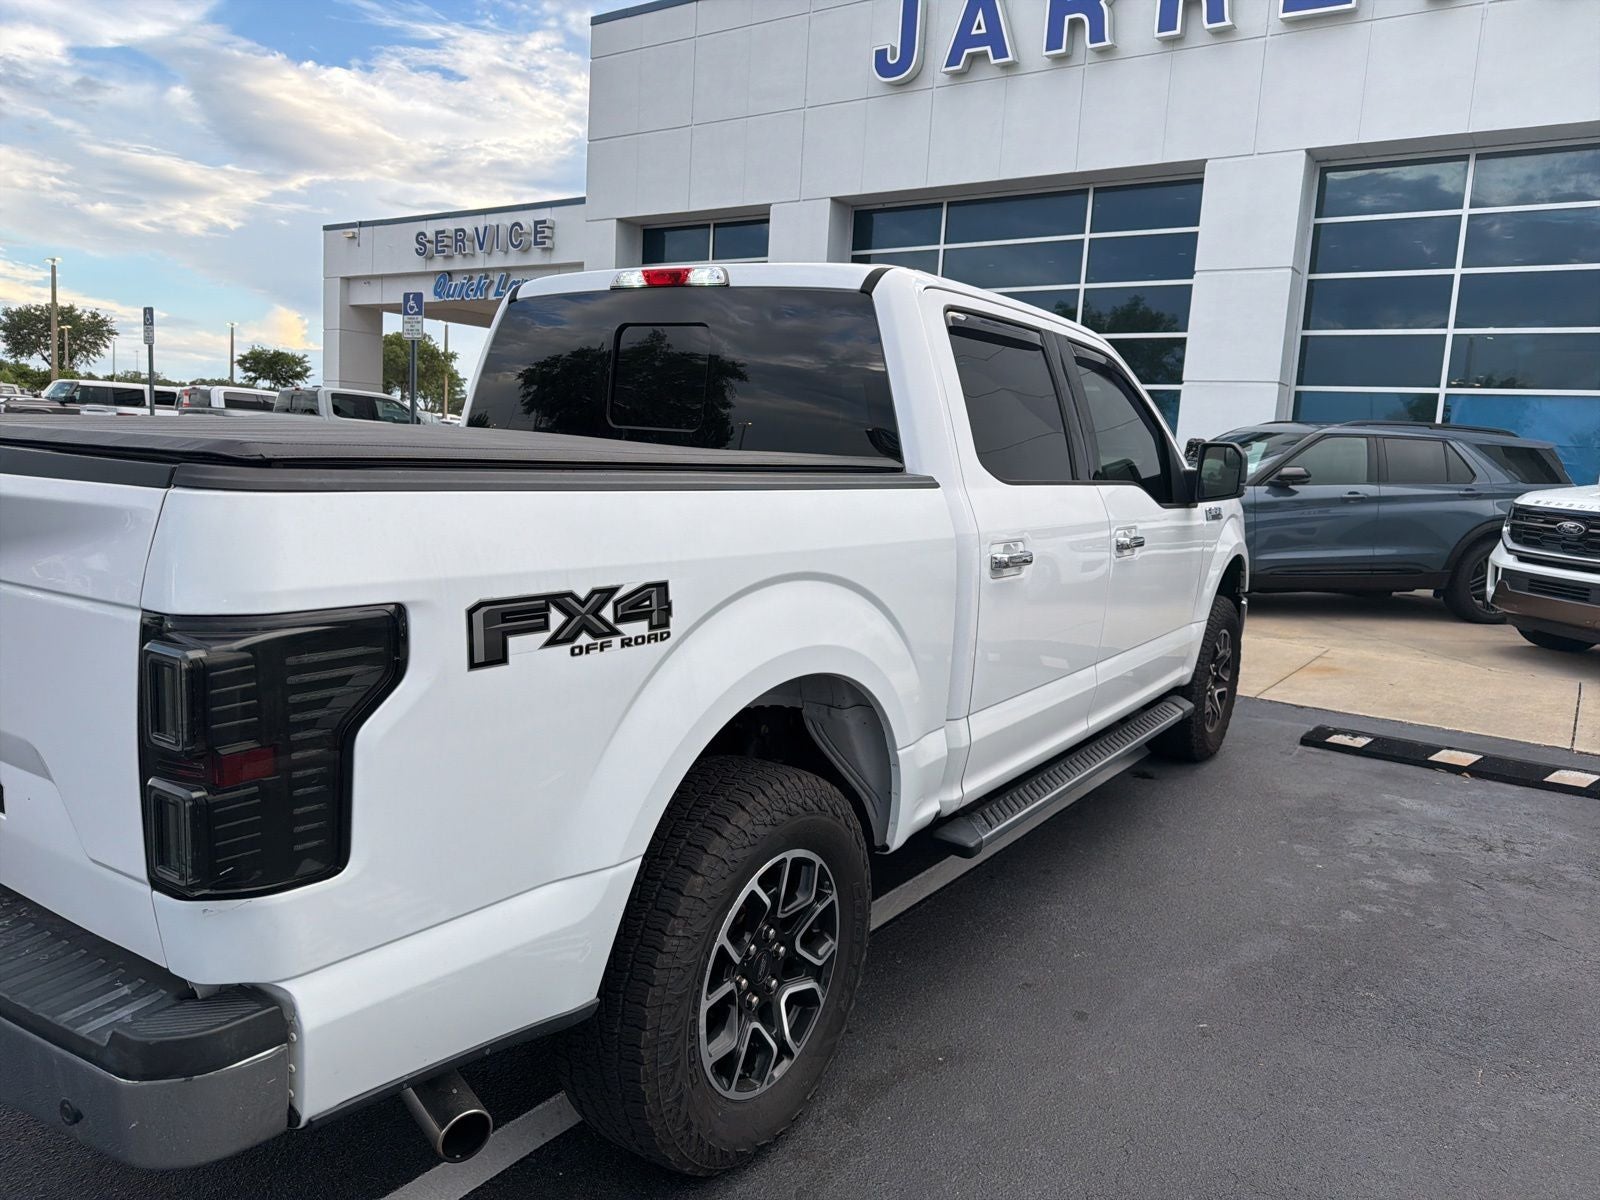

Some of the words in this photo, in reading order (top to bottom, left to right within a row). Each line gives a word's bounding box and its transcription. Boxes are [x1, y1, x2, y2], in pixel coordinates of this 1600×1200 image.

[414, 218, 555, 258] SERVICE
[433, 272, 492, 300] Quick
[465, 580, 672, 672] FX4
[570, 640, 612, 657] OFF
[620, 630, 671, 648] ROAD
